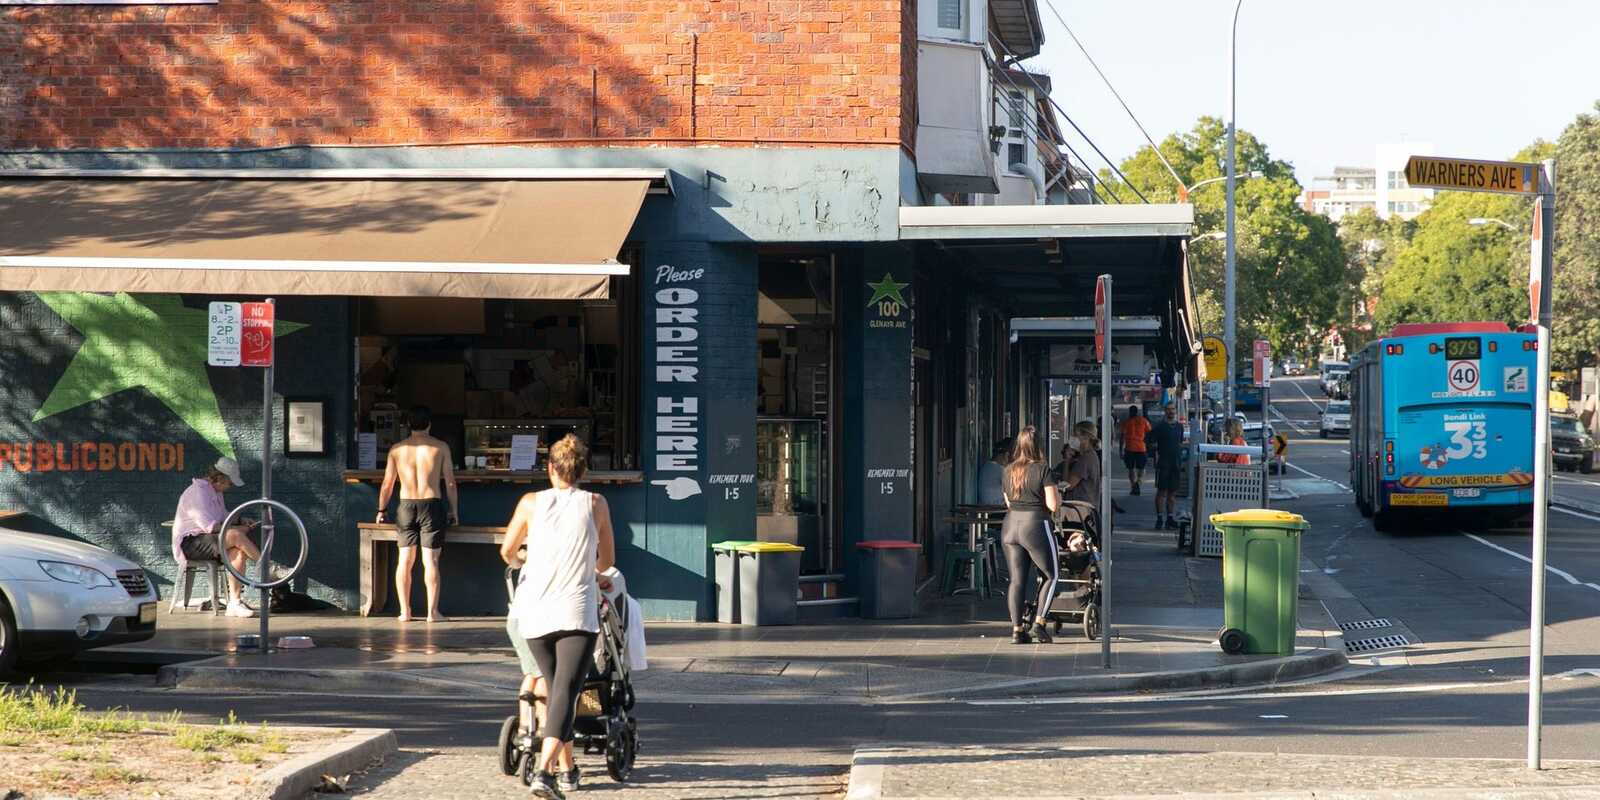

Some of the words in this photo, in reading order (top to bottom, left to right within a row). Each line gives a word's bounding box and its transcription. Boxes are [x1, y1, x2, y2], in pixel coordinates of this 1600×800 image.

[1416, 161, 1485, 186] WARNERS
[1491, 166, 1516, 189] AVE
[655, 264, 704, 284] Please
[251, 307, 264, 317] NO
[879, 301, 900, 317] 100
[242, 318, 272, 327] STOPP
[216, 326, 233, 336] 2P
[655, 287, 699, 382] ORDER
[1448, 340, 1479, 356] 379
[1453, 368, 1476, 384] 40
[1443, 413, 1468, 421] Bondi
[1469, 413, 1487, 421] Link
[656, 397, 699, 471] HERE
[0, 441, 185, 473] PUBLICBONDI
[708, 474, 740, 484] REMEMBER
[1430, 476, 1457, 485] LONG
[1460, 475, 1503, 484] VEHICLE
